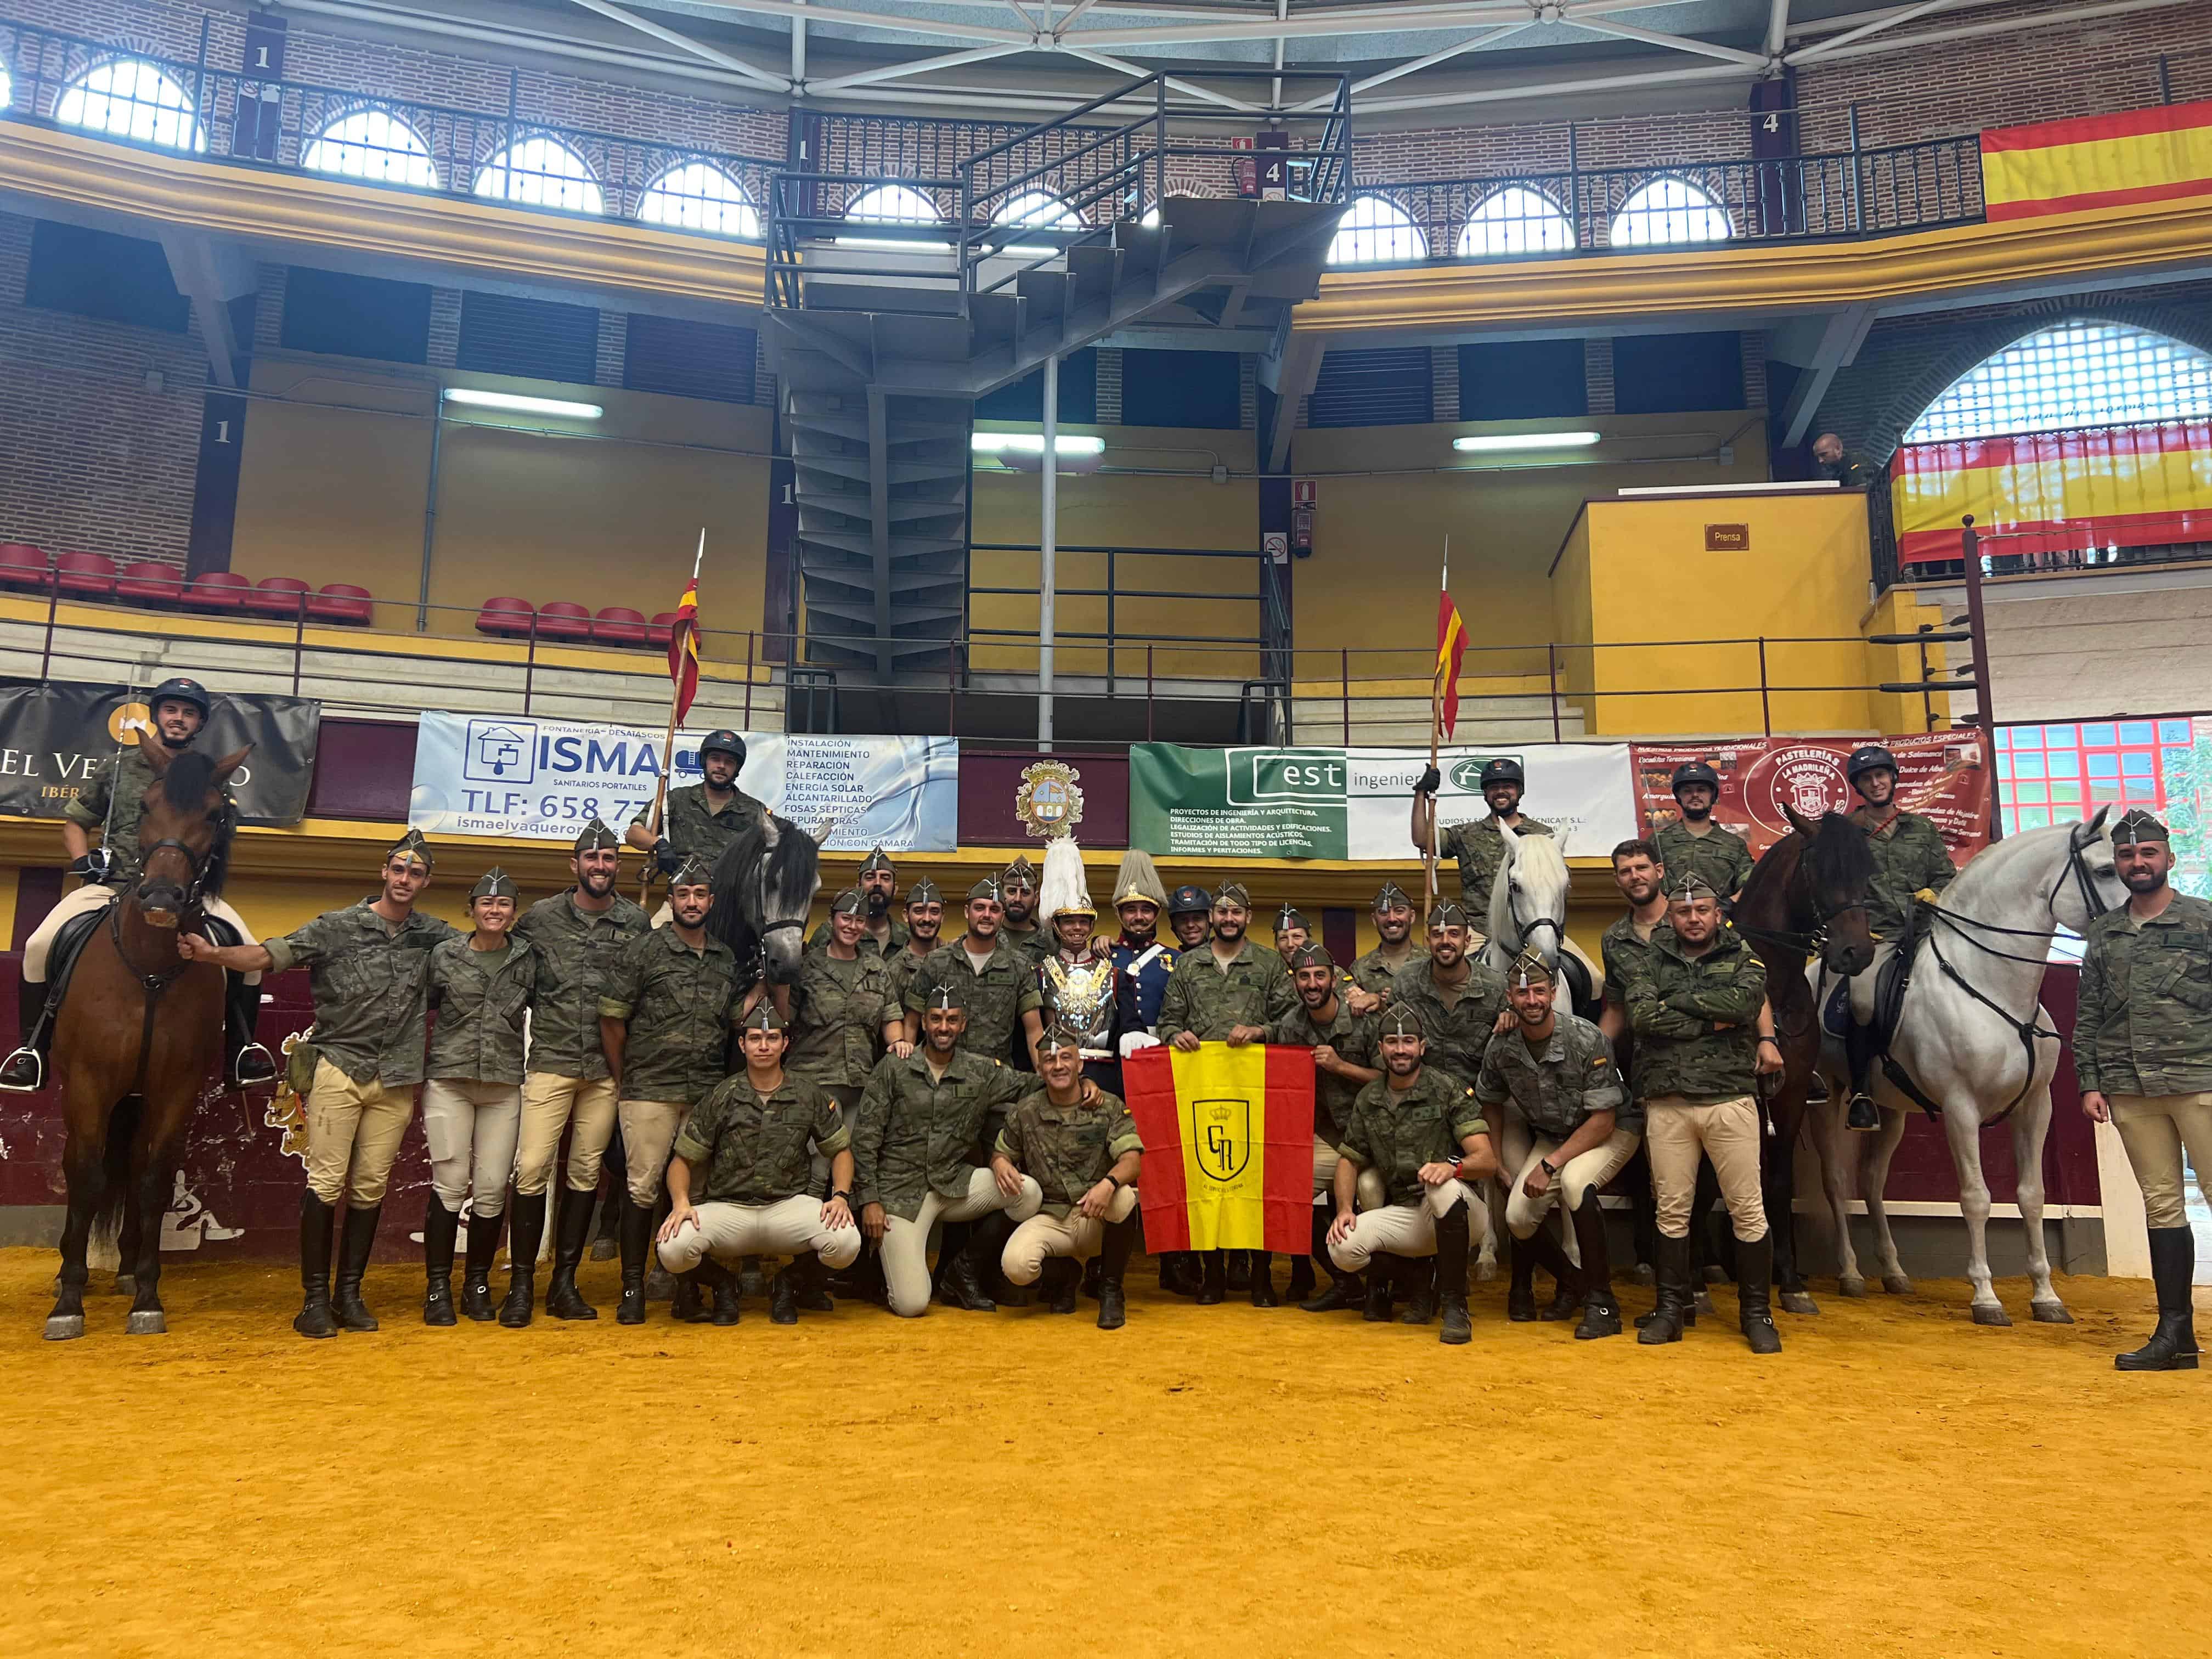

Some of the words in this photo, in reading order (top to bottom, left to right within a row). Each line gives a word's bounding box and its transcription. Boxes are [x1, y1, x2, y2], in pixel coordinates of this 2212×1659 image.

[255, 46, 270, 69] 1
[1763, 114, 1778, 133] 4
[1266, 162, 1280, 182] 4
[215, 420, 231, 443] 1
[781, 483, 794, 504] 1
[1715, 532, 1740, 541] Prensa
[609, 729, 665, 739] DESATASCOS
[1890, 736, 1931, 747] PRODUCTOS
[1933, 732, 1976, 742] ESPECIALES
[788, 738, 850, 747] INSTALACIÓN
[1713, 741, 1768, 751] TRADICIONALES
[539, 736, 661, 777] ISMA
[787, 749, 870, 758] MANTENIMIENTO
[1775, 750, 1840, 766] PASTELERÍAS
[787, 760, 850, 769] REPARACIÓN
[786, 772, 854, 781] CALEFACCIÓN
[1284, 763, 1341, 786] est
[1781, 768, 1792, 778] LA
[1792, 763, 1835, 780] MADRILEÑA
[554, 779, 600, 788] SANITARIOS
[602, 782, 647, 791] PORTATILES
[786, 782, 829, 791] ENERGÍA
[1355, 772, 1421, 789] ingenier
[461, 789, 527, 815] TLF:
[540, 795, 599, 820] 658
[786, 794, 872, 803] ALCANTARILLADO
[1266, 808, 1318, 816] ARQUITECTURA.
[1282, 823, 1332, 832] EDIFICACIONES.
